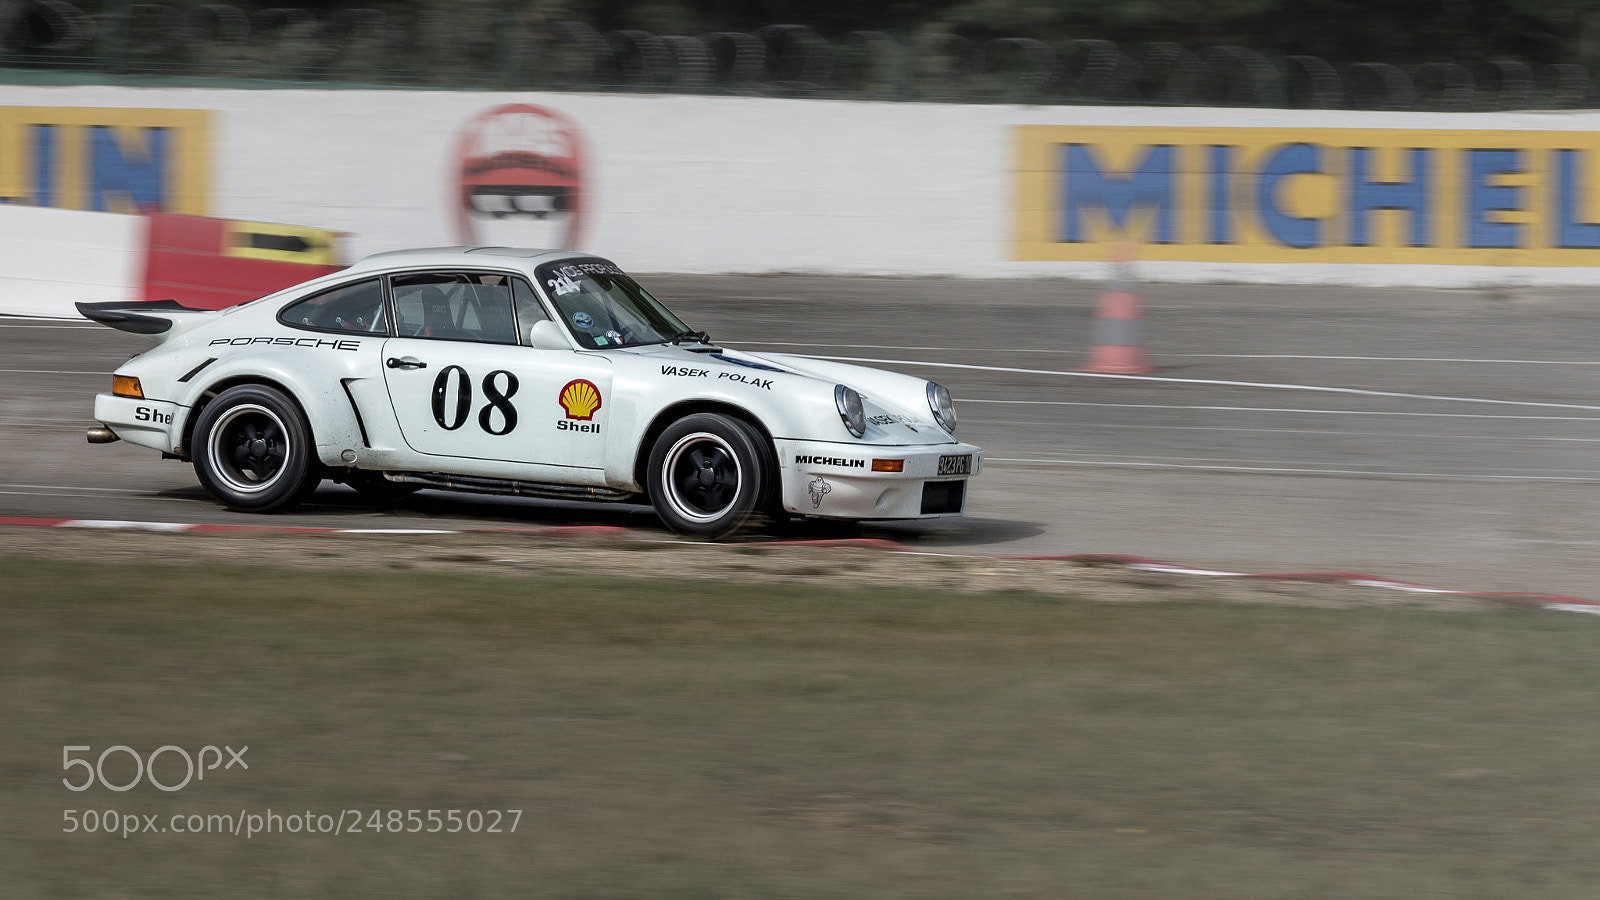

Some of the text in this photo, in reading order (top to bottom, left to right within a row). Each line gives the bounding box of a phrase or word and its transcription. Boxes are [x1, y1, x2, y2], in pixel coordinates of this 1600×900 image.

[208, 337, 361, 351] PORSCHE
[661, 365, 774, 390] VASEK POLAK
[431, 364, 519, 436] 08
[556, 420, 600, 434] Shell
[795, 455, 865, 468] MICHELIN
